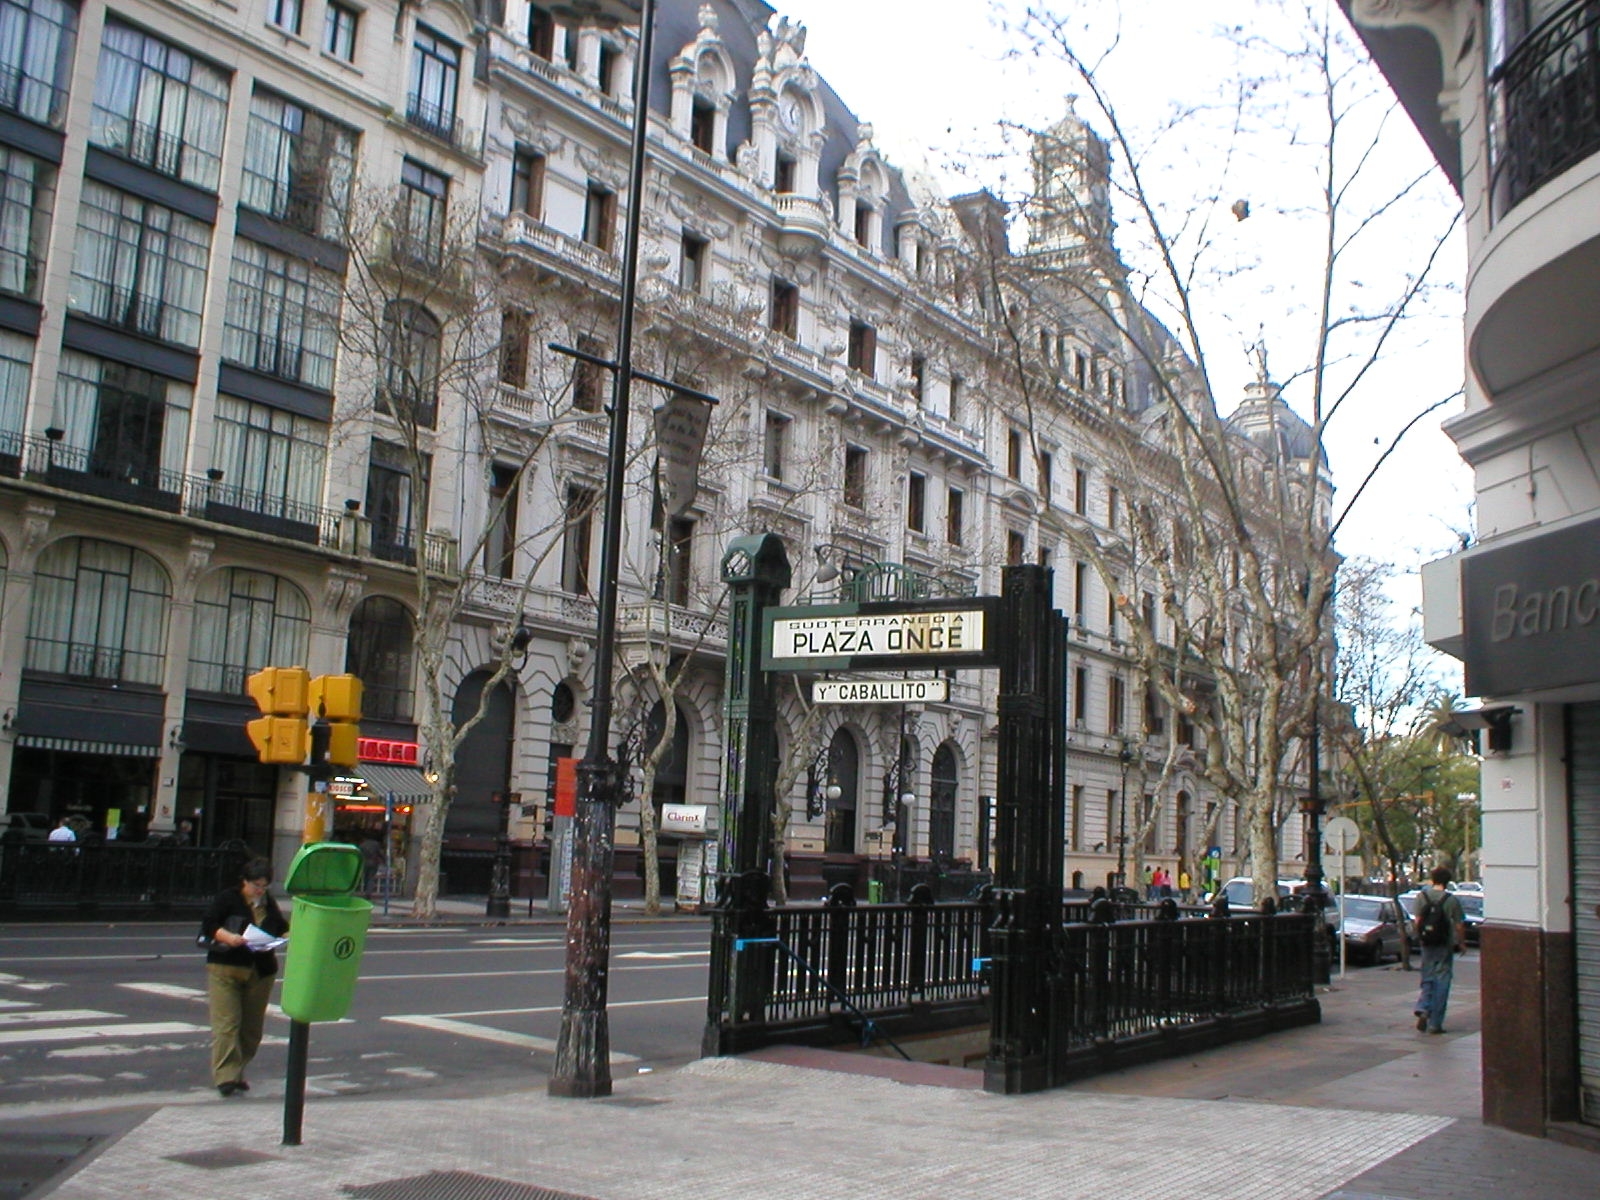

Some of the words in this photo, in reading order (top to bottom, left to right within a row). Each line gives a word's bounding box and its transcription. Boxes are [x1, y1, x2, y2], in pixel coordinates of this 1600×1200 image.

[789, 615, 945, 629] SUBTERRANEO
[953, 614, 964, 622] A
[793, 629, 874, 654] PLAZA
[887, 626, 963, 650] ONCE
